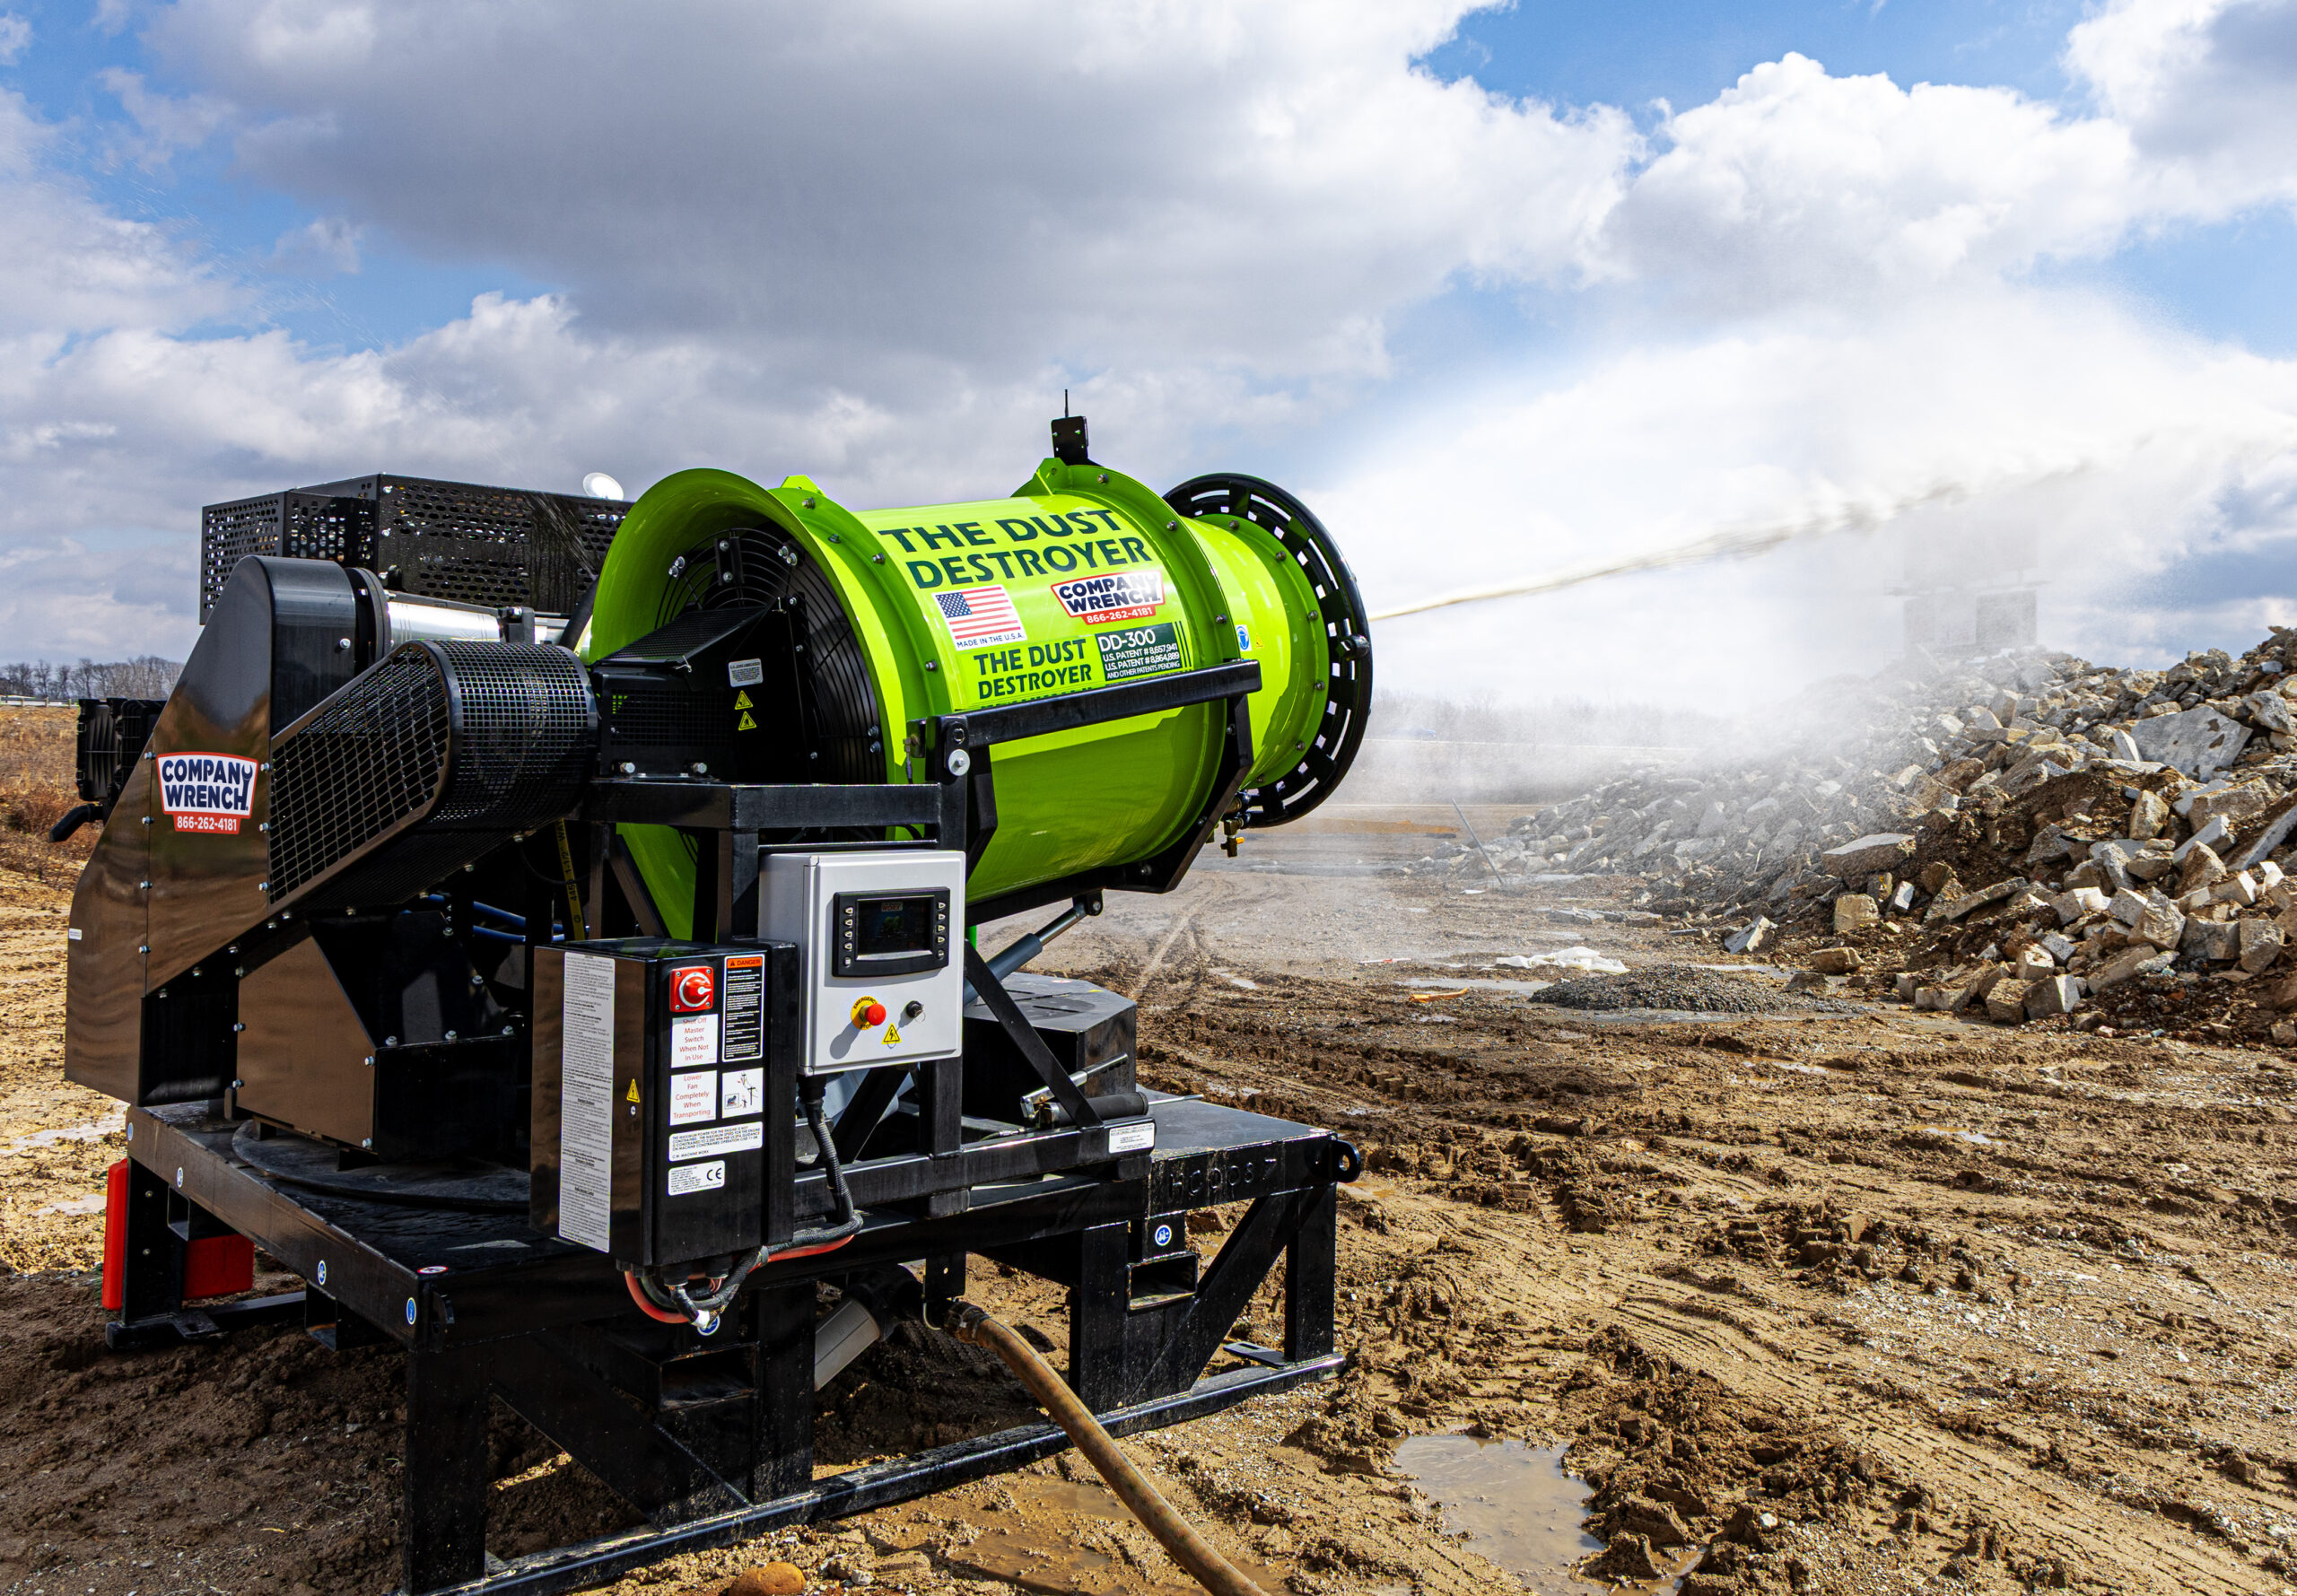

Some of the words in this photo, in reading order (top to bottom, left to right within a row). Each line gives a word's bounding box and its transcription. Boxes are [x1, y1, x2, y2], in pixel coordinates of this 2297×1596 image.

[878, 521, 996, 553] THE
[995, 510, 1122, 542] DUST
[906, 536, 1153, 589] DESTROYER
[1059, 574, 1158, 599] COMPANY
[1066, 589, 1158, 613] WRENCH
[1087, 607, 1153, 623] 866-262-4181
[956, 640, 978, 648] MADE
[989, 635, 1004, 643] THE
[1005, 632, 1025, 641] U.S.A.
[1097, 629, 1156, 652] DD-300
[974, 649, 1023, 675] THE
[1028, 639, 1087, 667] DUST
[1115, 649, 1142, 659] PATENT
[1117, 658, 1144, 669] PATENT
[1119, 669, 1137, 677] OTHER
[1137, 666, 1157, 674] PATENTS
[1157, 661, 1180, 671] PENDING
[978, 664, 1092, 700] DESTROYER
[162, 759, 253, 785] COMPANY
[164, 784, 249, 811] WRENCH
[177, 815, 237, 831] 866-262-4181
[676, 1091, 710, 1101] Completely
[673, 1109, 711, 1119] Transporting
[706, 1167, 722, 1181] CE
